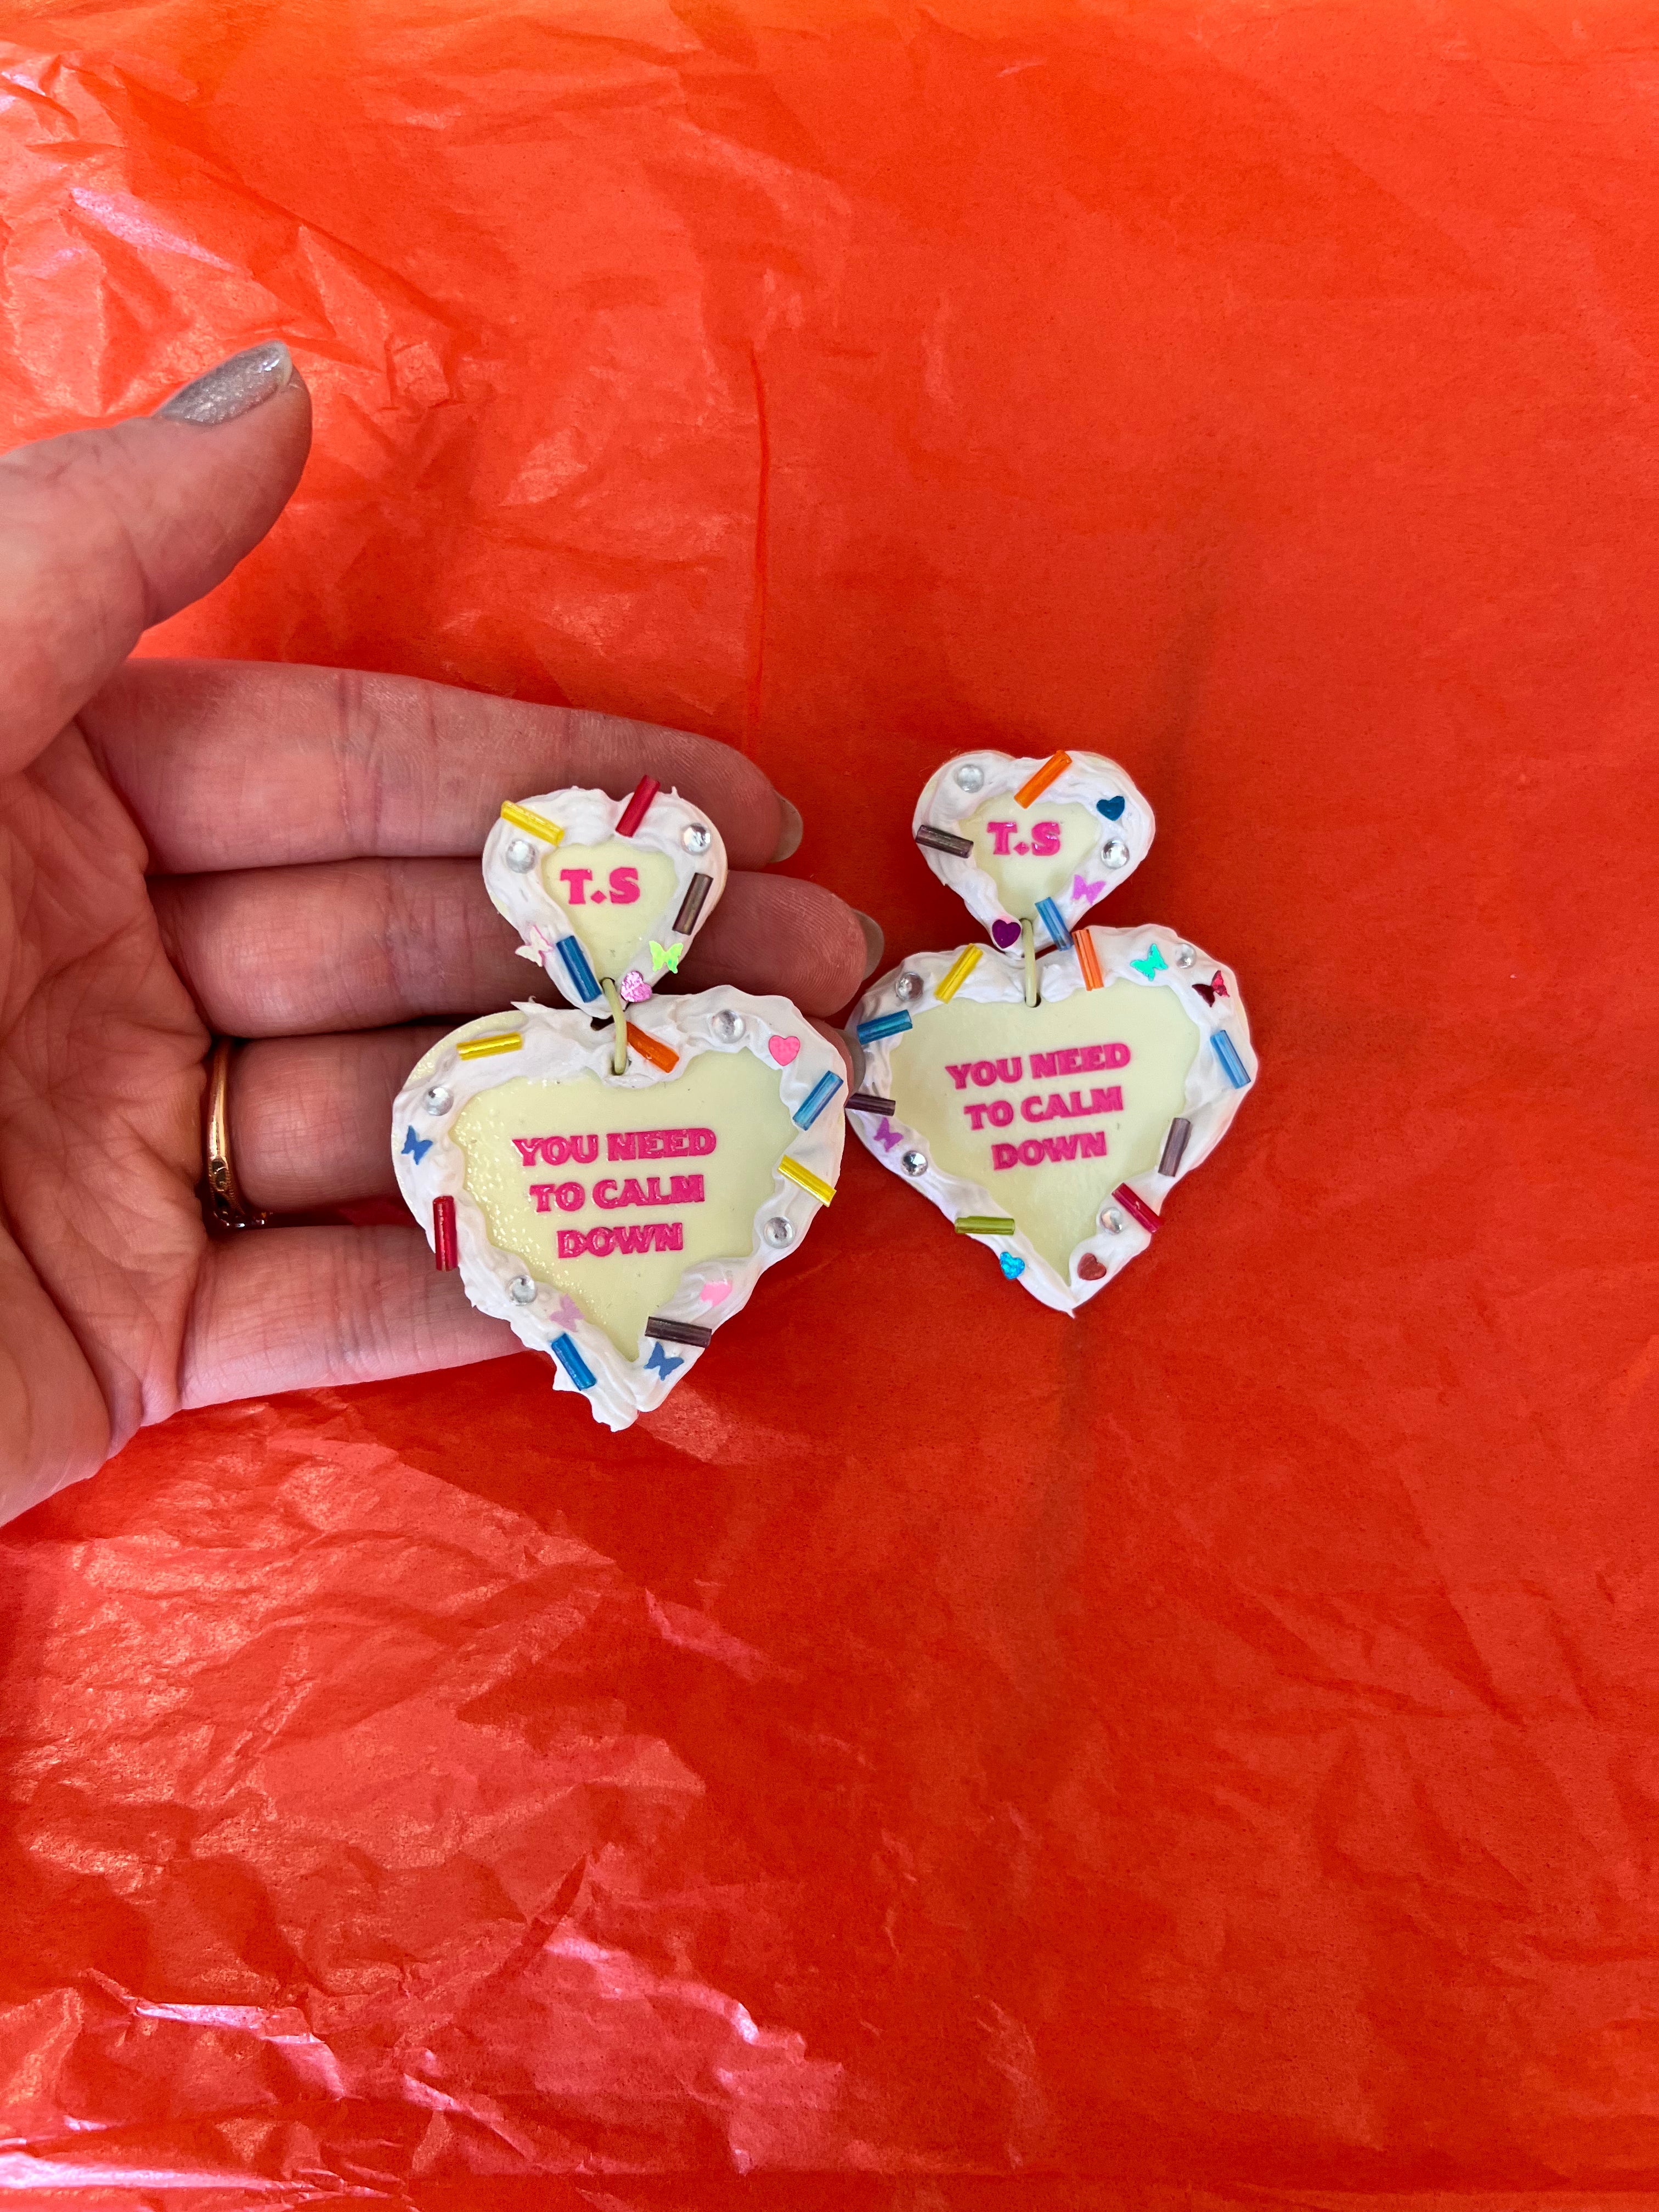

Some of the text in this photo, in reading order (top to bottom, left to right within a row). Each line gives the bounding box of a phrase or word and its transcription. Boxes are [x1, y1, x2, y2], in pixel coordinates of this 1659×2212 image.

[988, 822, 1060, 855] T.S
[561, 867, 640, 904] T.S
[946, 1043, 1130, 1089] YOU NEED
[964, 1086, 1123, 1130] TO CALM
[513, 1128, 716, 1166] YOU NEED
[992, 1132, 1107, 1170] DOWN
[530, 1175, 704, 1212] TO CALM
[557, 1223, 683, 1259] DOWN
